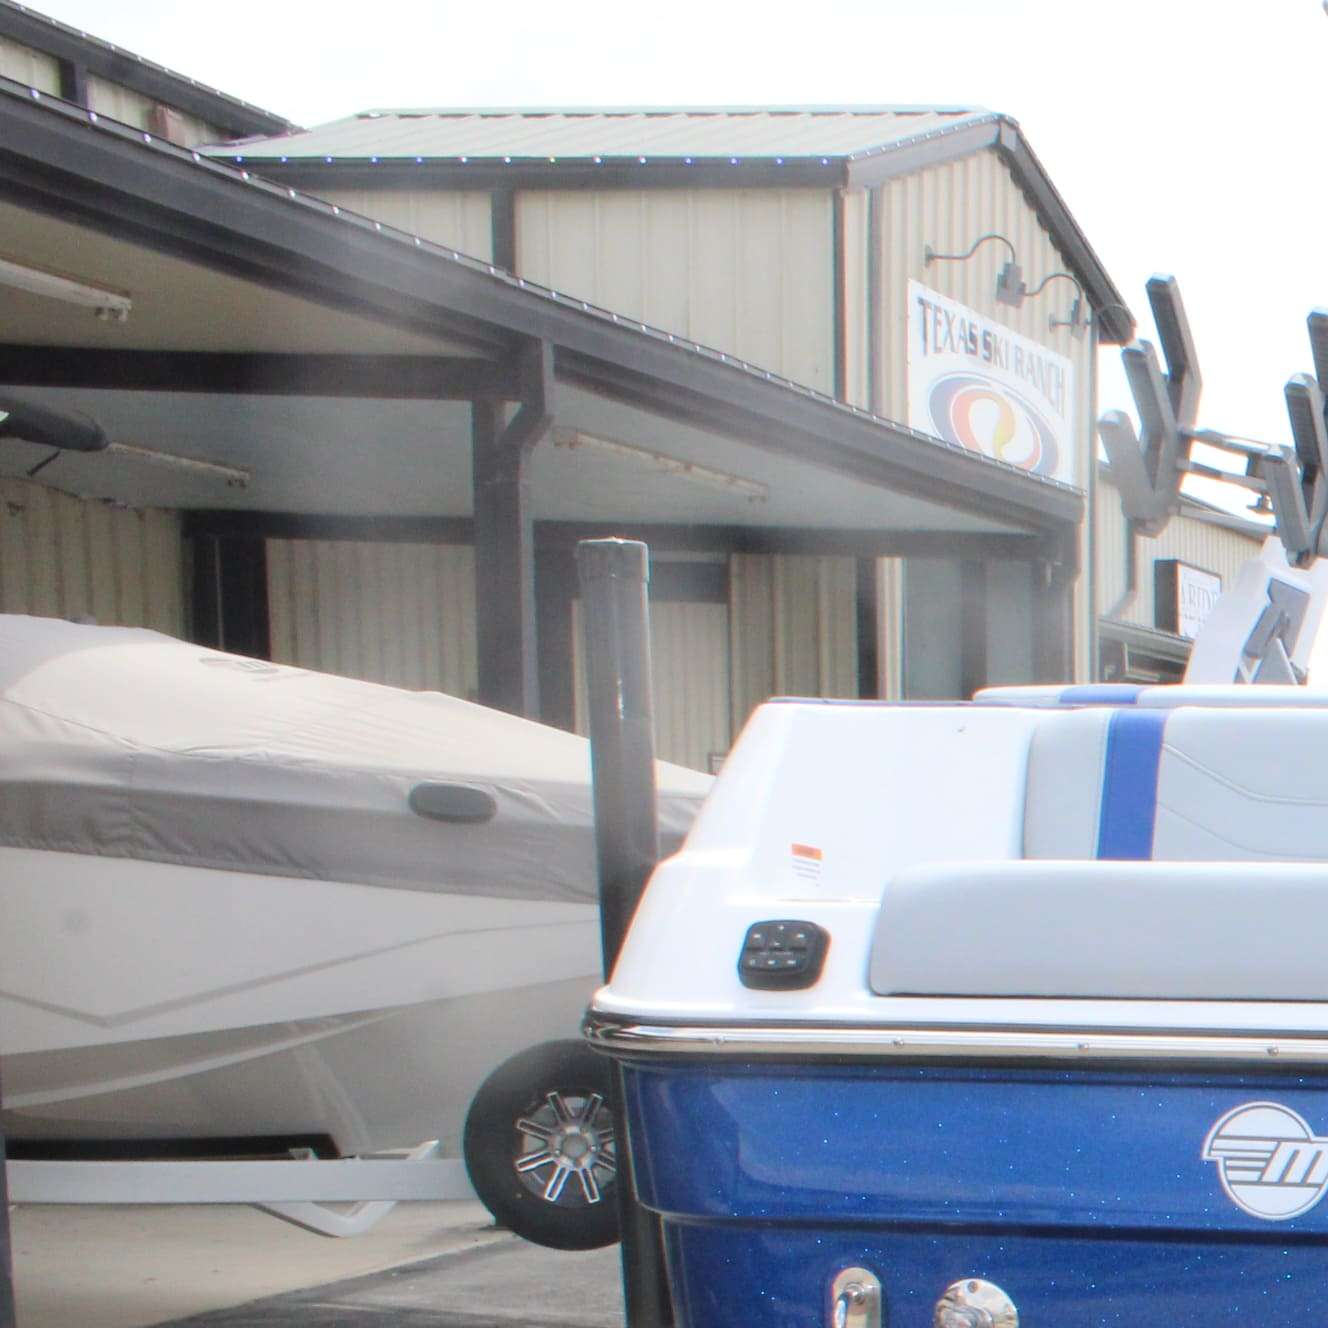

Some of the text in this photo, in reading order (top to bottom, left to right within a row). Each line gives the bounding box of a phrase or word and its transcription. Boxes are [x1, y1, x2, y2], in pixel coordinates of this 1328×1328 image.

[917, 296, 1065, 420] TEXAS SKI RANCH
